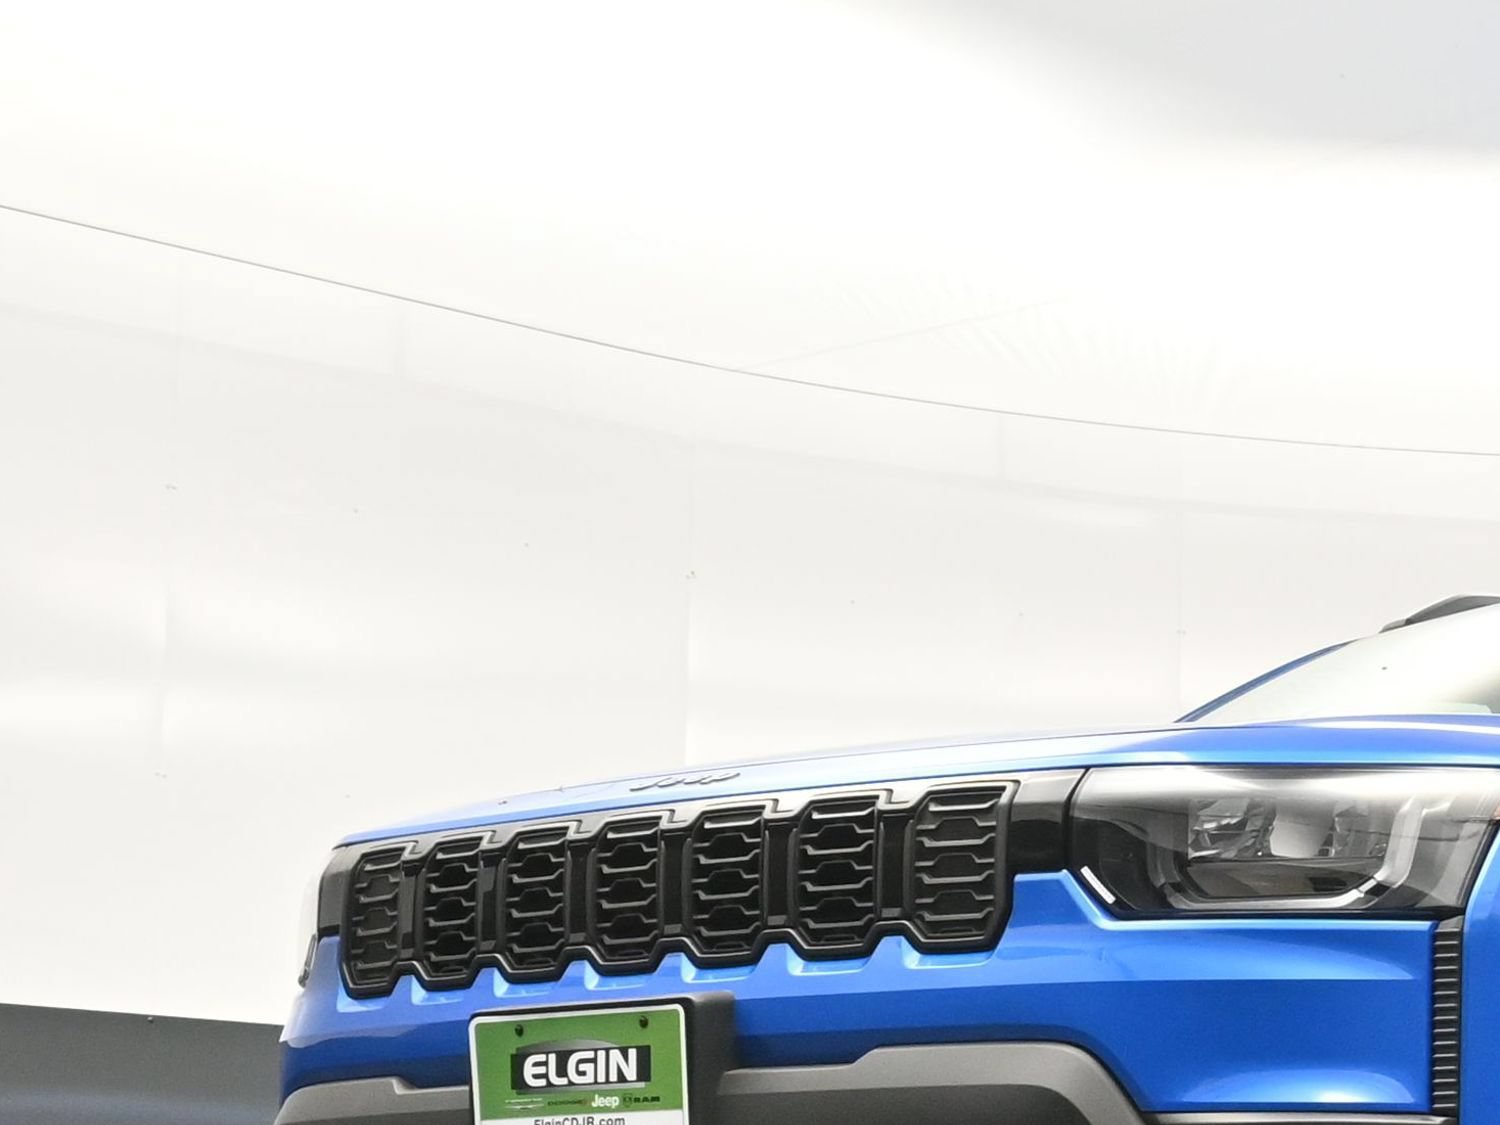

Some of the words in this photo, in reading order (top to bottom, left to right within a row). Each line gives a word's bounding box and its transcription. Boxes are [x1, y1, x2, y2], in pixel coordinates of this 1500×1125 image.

[523, 1047, 637, 1088] ELGIN
[591, 1094, 620, 1108] Jeep
[633, 1095, 660, 1104] RAM
